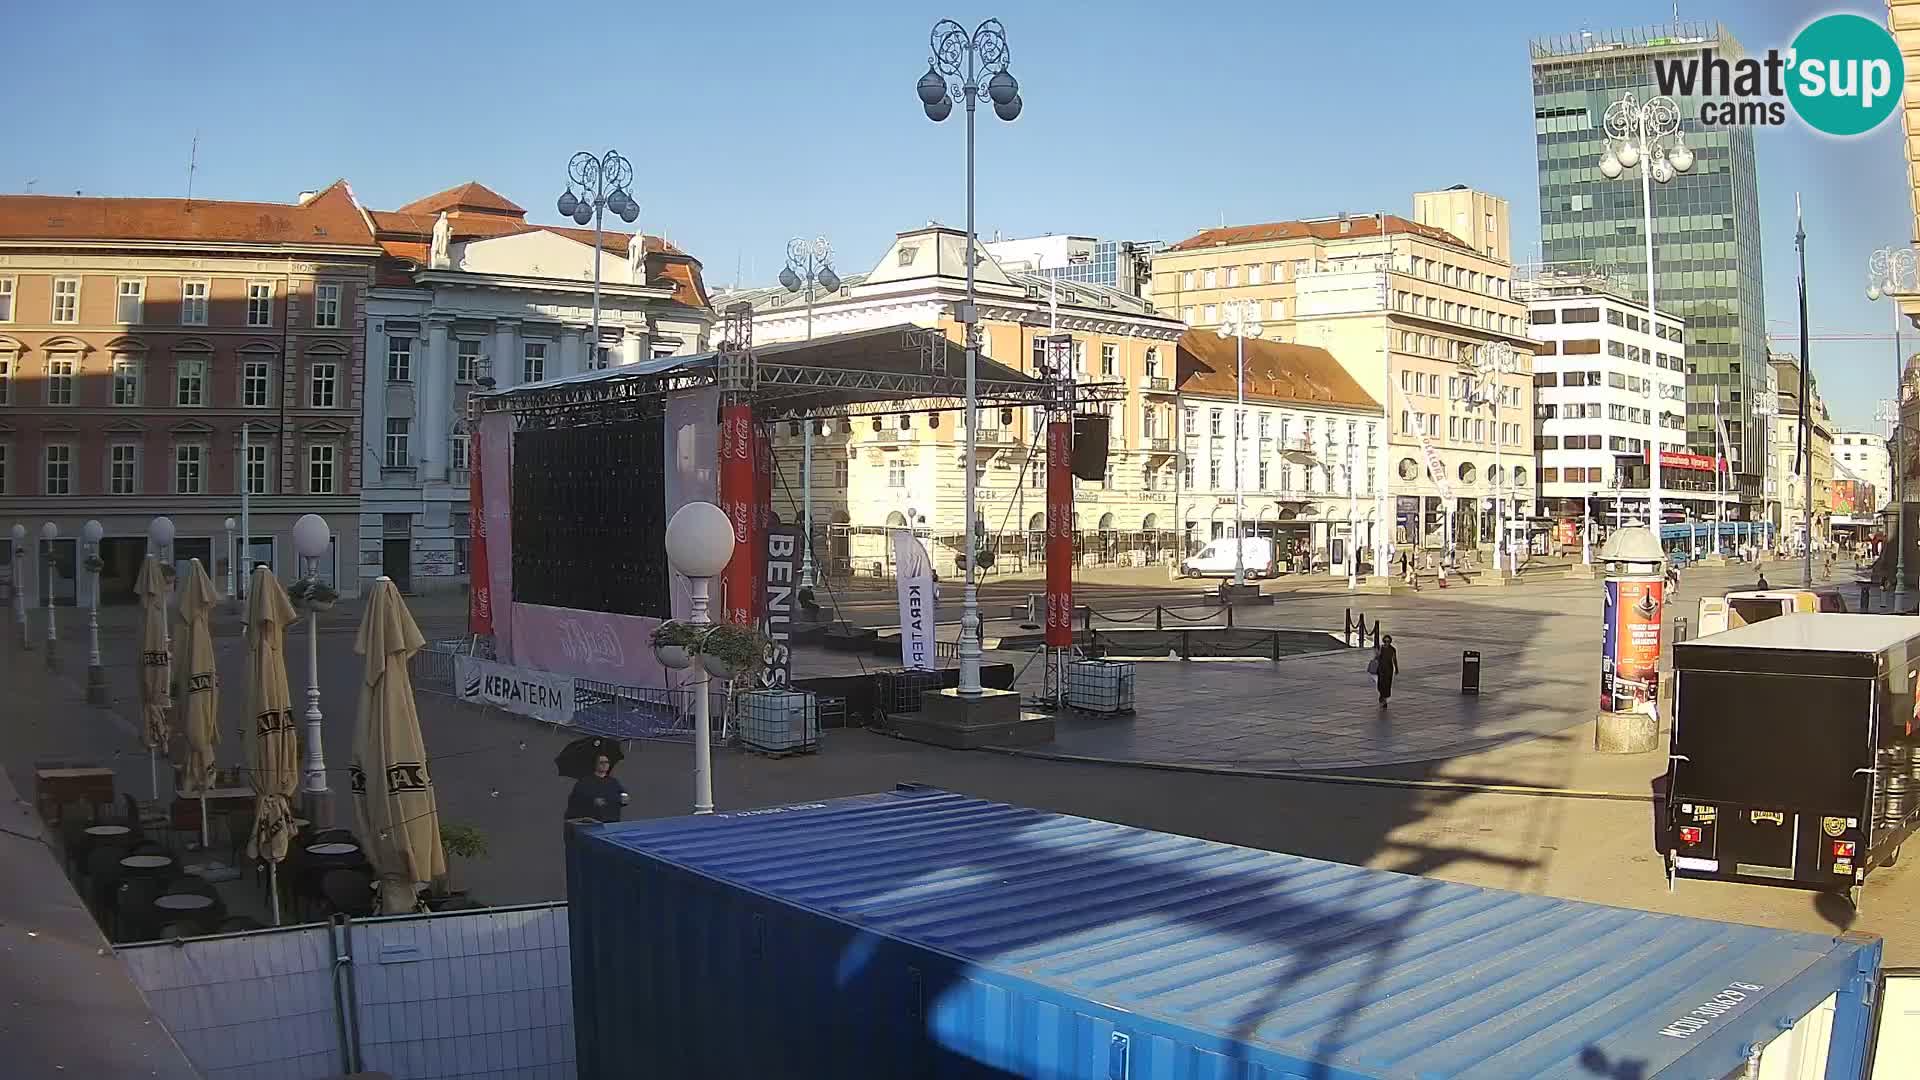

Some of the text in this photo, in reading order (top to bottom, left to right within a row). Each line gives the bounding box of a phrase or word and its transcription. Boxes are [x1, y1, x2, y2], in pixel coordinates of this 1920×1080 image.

[484, 674, 563, 711] KERATERM
[1658, 1015, 1710, 1039] MCDU
[1691, 989, 1748, 1018] 300629
